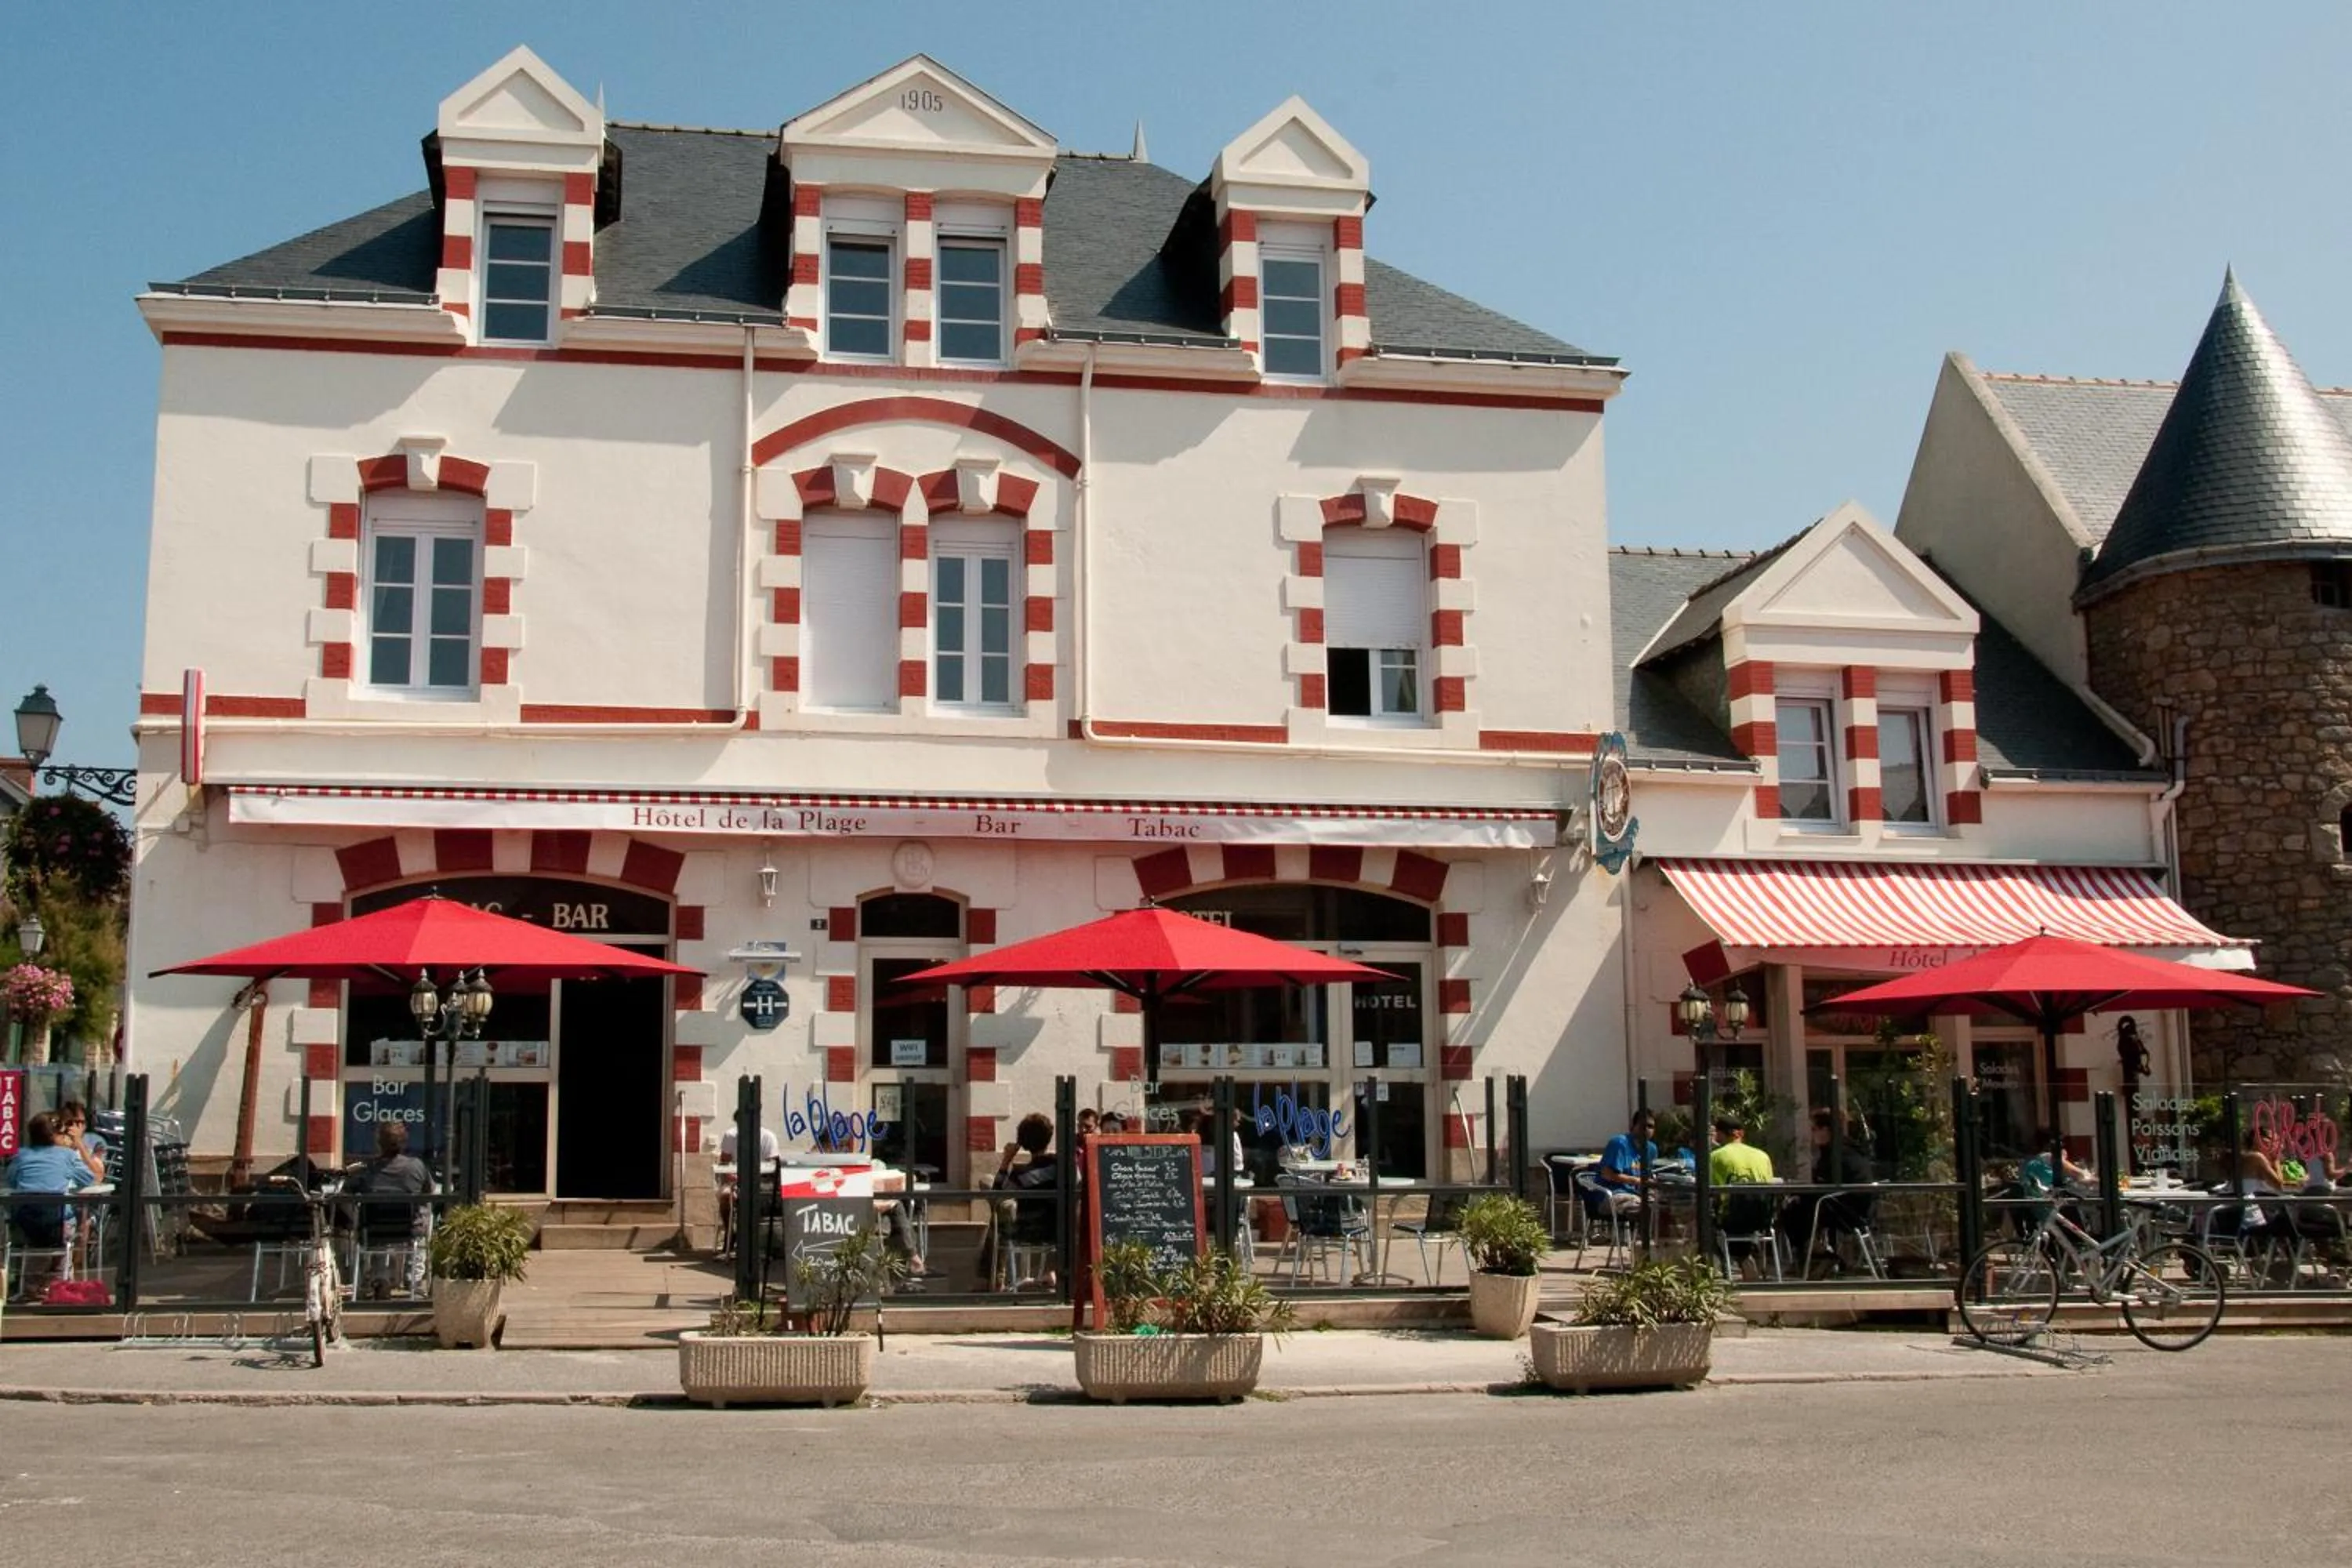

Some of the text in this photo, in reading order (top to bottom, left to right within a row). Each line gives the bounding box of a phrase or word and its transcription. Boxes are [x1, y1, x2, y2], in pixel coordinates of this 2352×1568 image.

[902, 89, 943, 111] 1905
[632, 807, 706, 829] Hôtel
[717, 809, 748, 829] de
[762, 811, 783, 829] la
[798, 811, 866, 833] Plage
[975, 815, 1022, 834] Bar
[1127, 818, 1201, 838] Tabac
[552, 903, 609, 929] BAR
[1889, 946, 1949, 969] Hôtel
[757, 996, 773, 1015] H
[1354, 995, 1417, 1009] HOTEL
[372, 1074, 409, 1095] Bar
[1, 1076, 16, 1149] TABAC
[353, 1101, 425, 1123] Glaces
[2132, 1117, 2200, 1137] Poissons
[796, 1203, 857, 1236] TABAC
